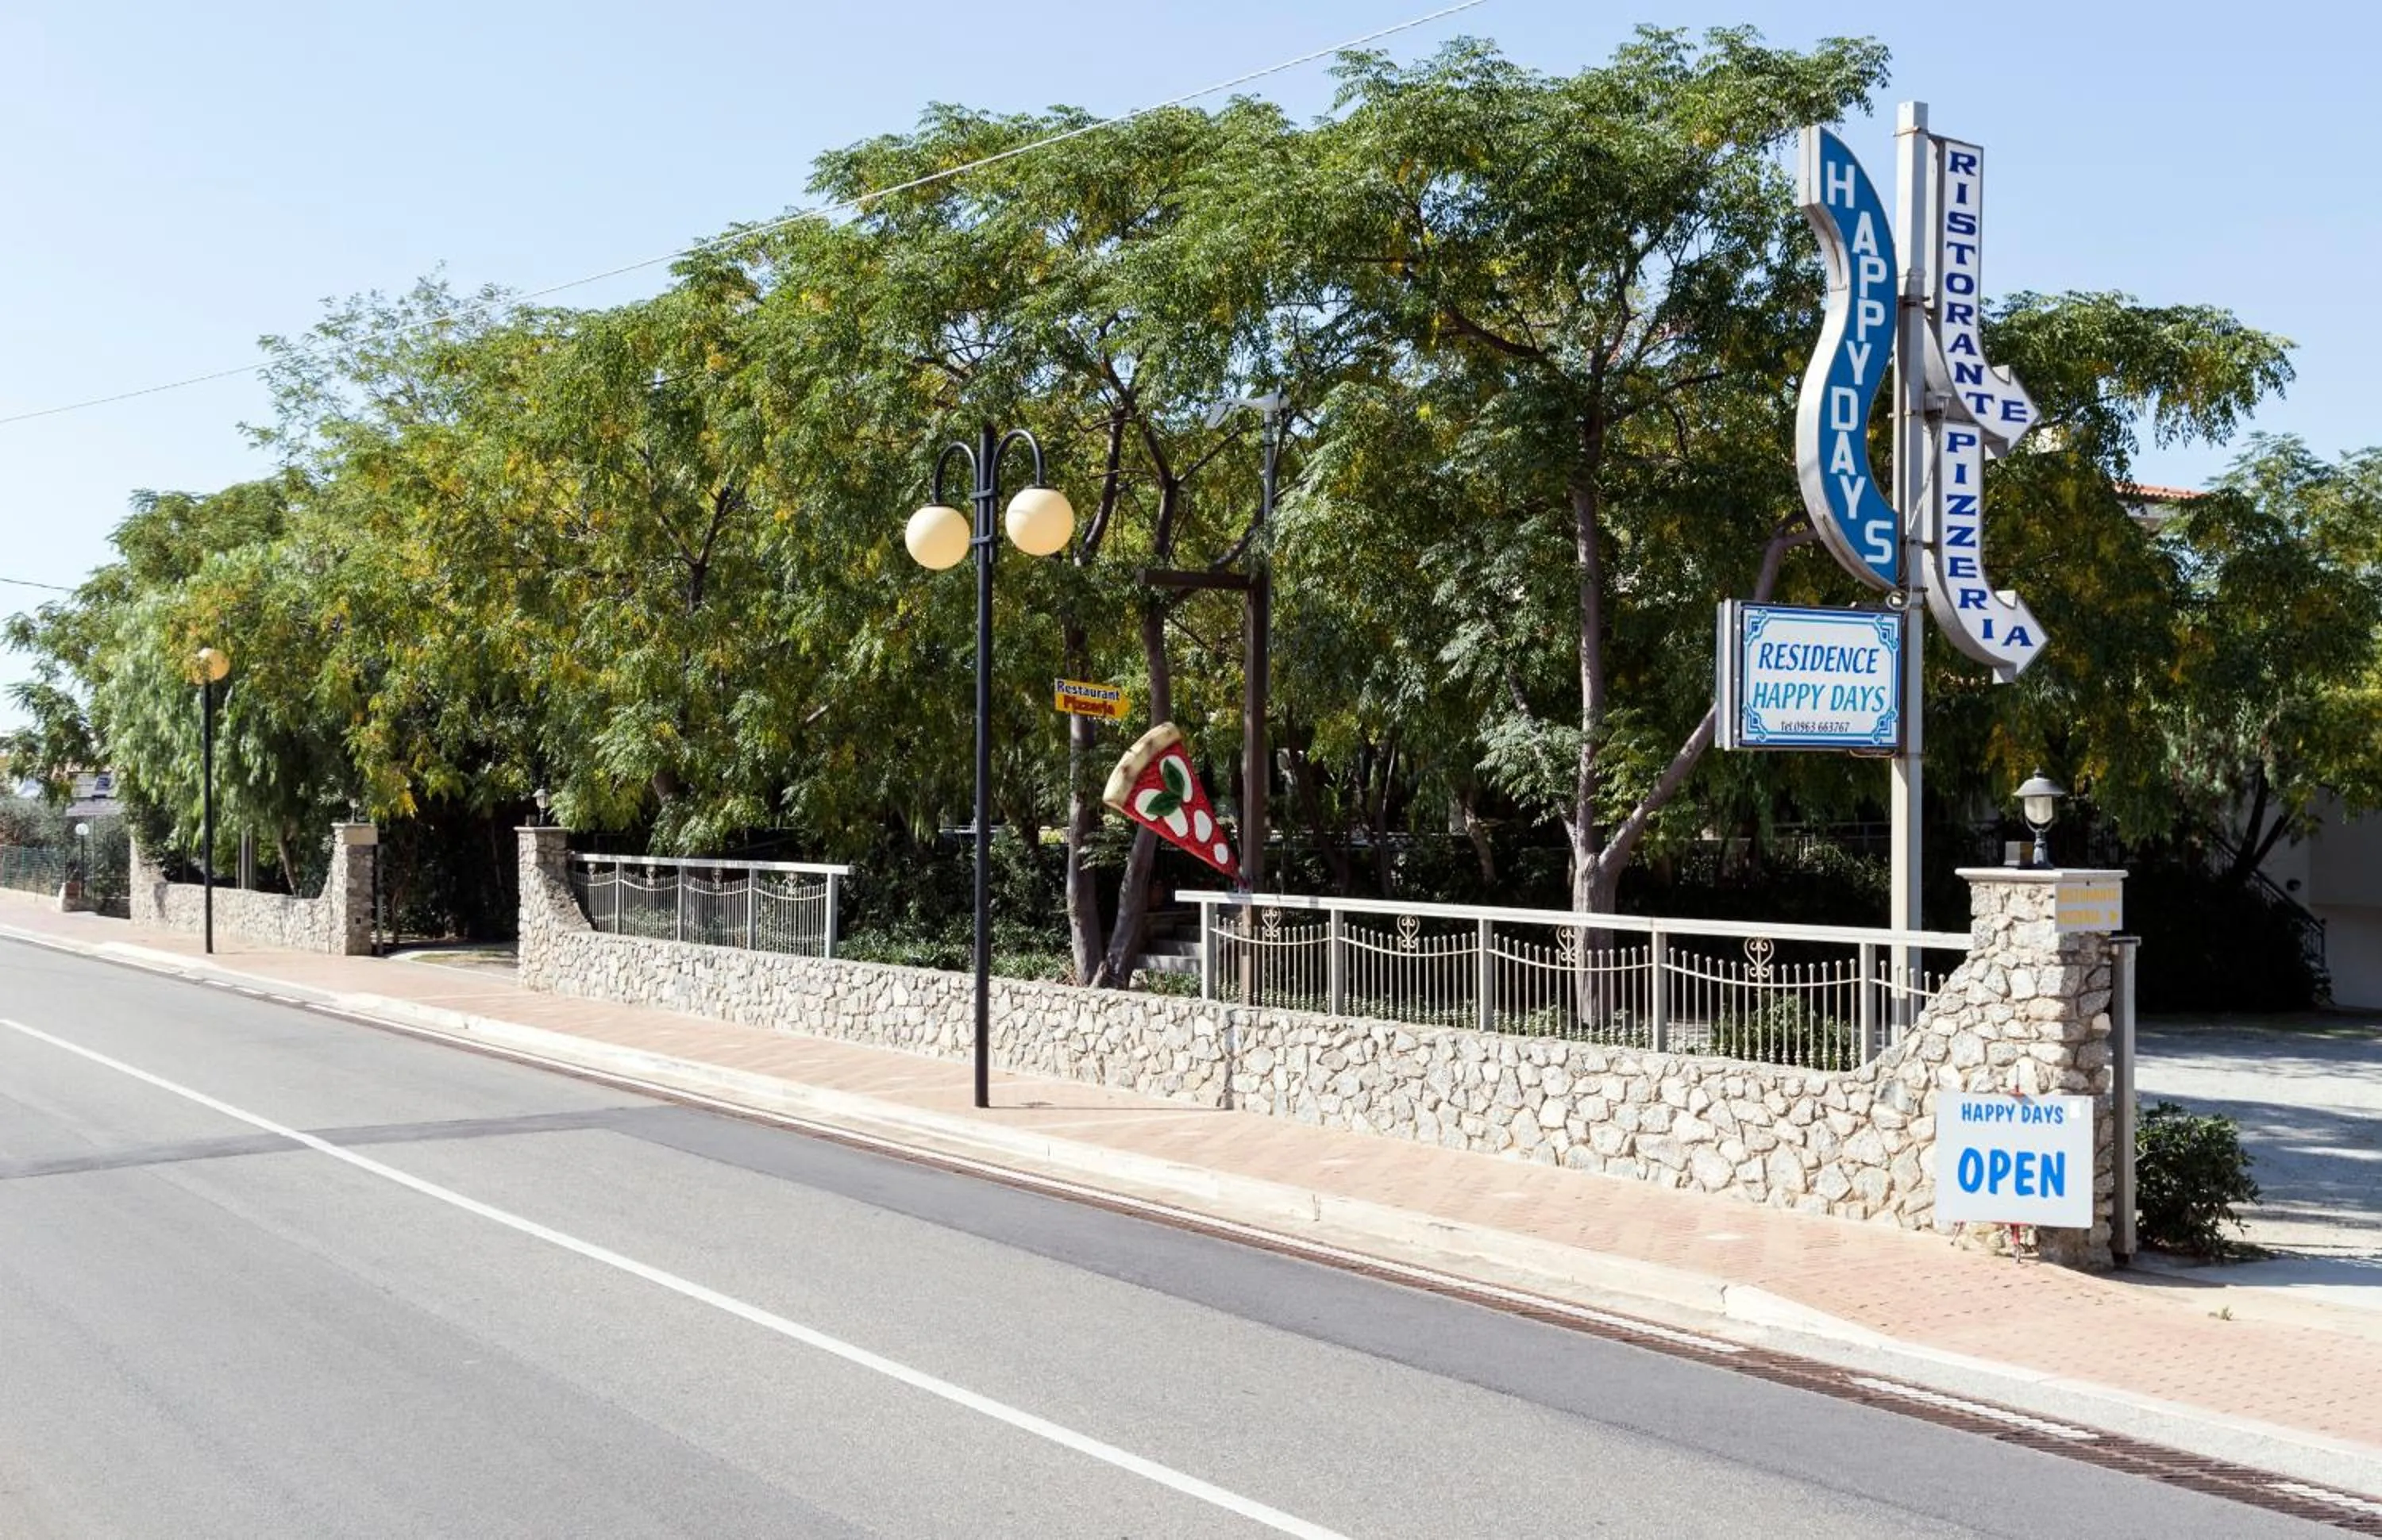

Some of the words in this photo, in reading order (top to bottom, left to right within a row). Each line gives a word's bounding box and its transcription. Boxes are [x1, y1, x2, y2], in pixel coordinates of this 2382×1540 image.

[1826, 160, 1887, 385] HAPPY
[1945, 150, 2029, 423] RISTORANTE
[1829, 386, 1894, 565] DAYS
[1945, 431, 2033, 647] PIZZERIA
[1758, 642, 1880, 674] RESIDENCE
[1057, 680, 1120, 700] Restaurant
[1752, 682, 1825, 710] HAPPY
[1829, 685, 1887, 712] DAYS
[1961, 1103, 2016, 1123] HAPPY
[2022, 1103, 2064, 1124] DAYS
[1957, 1147, 2066, 1198] OPEN
